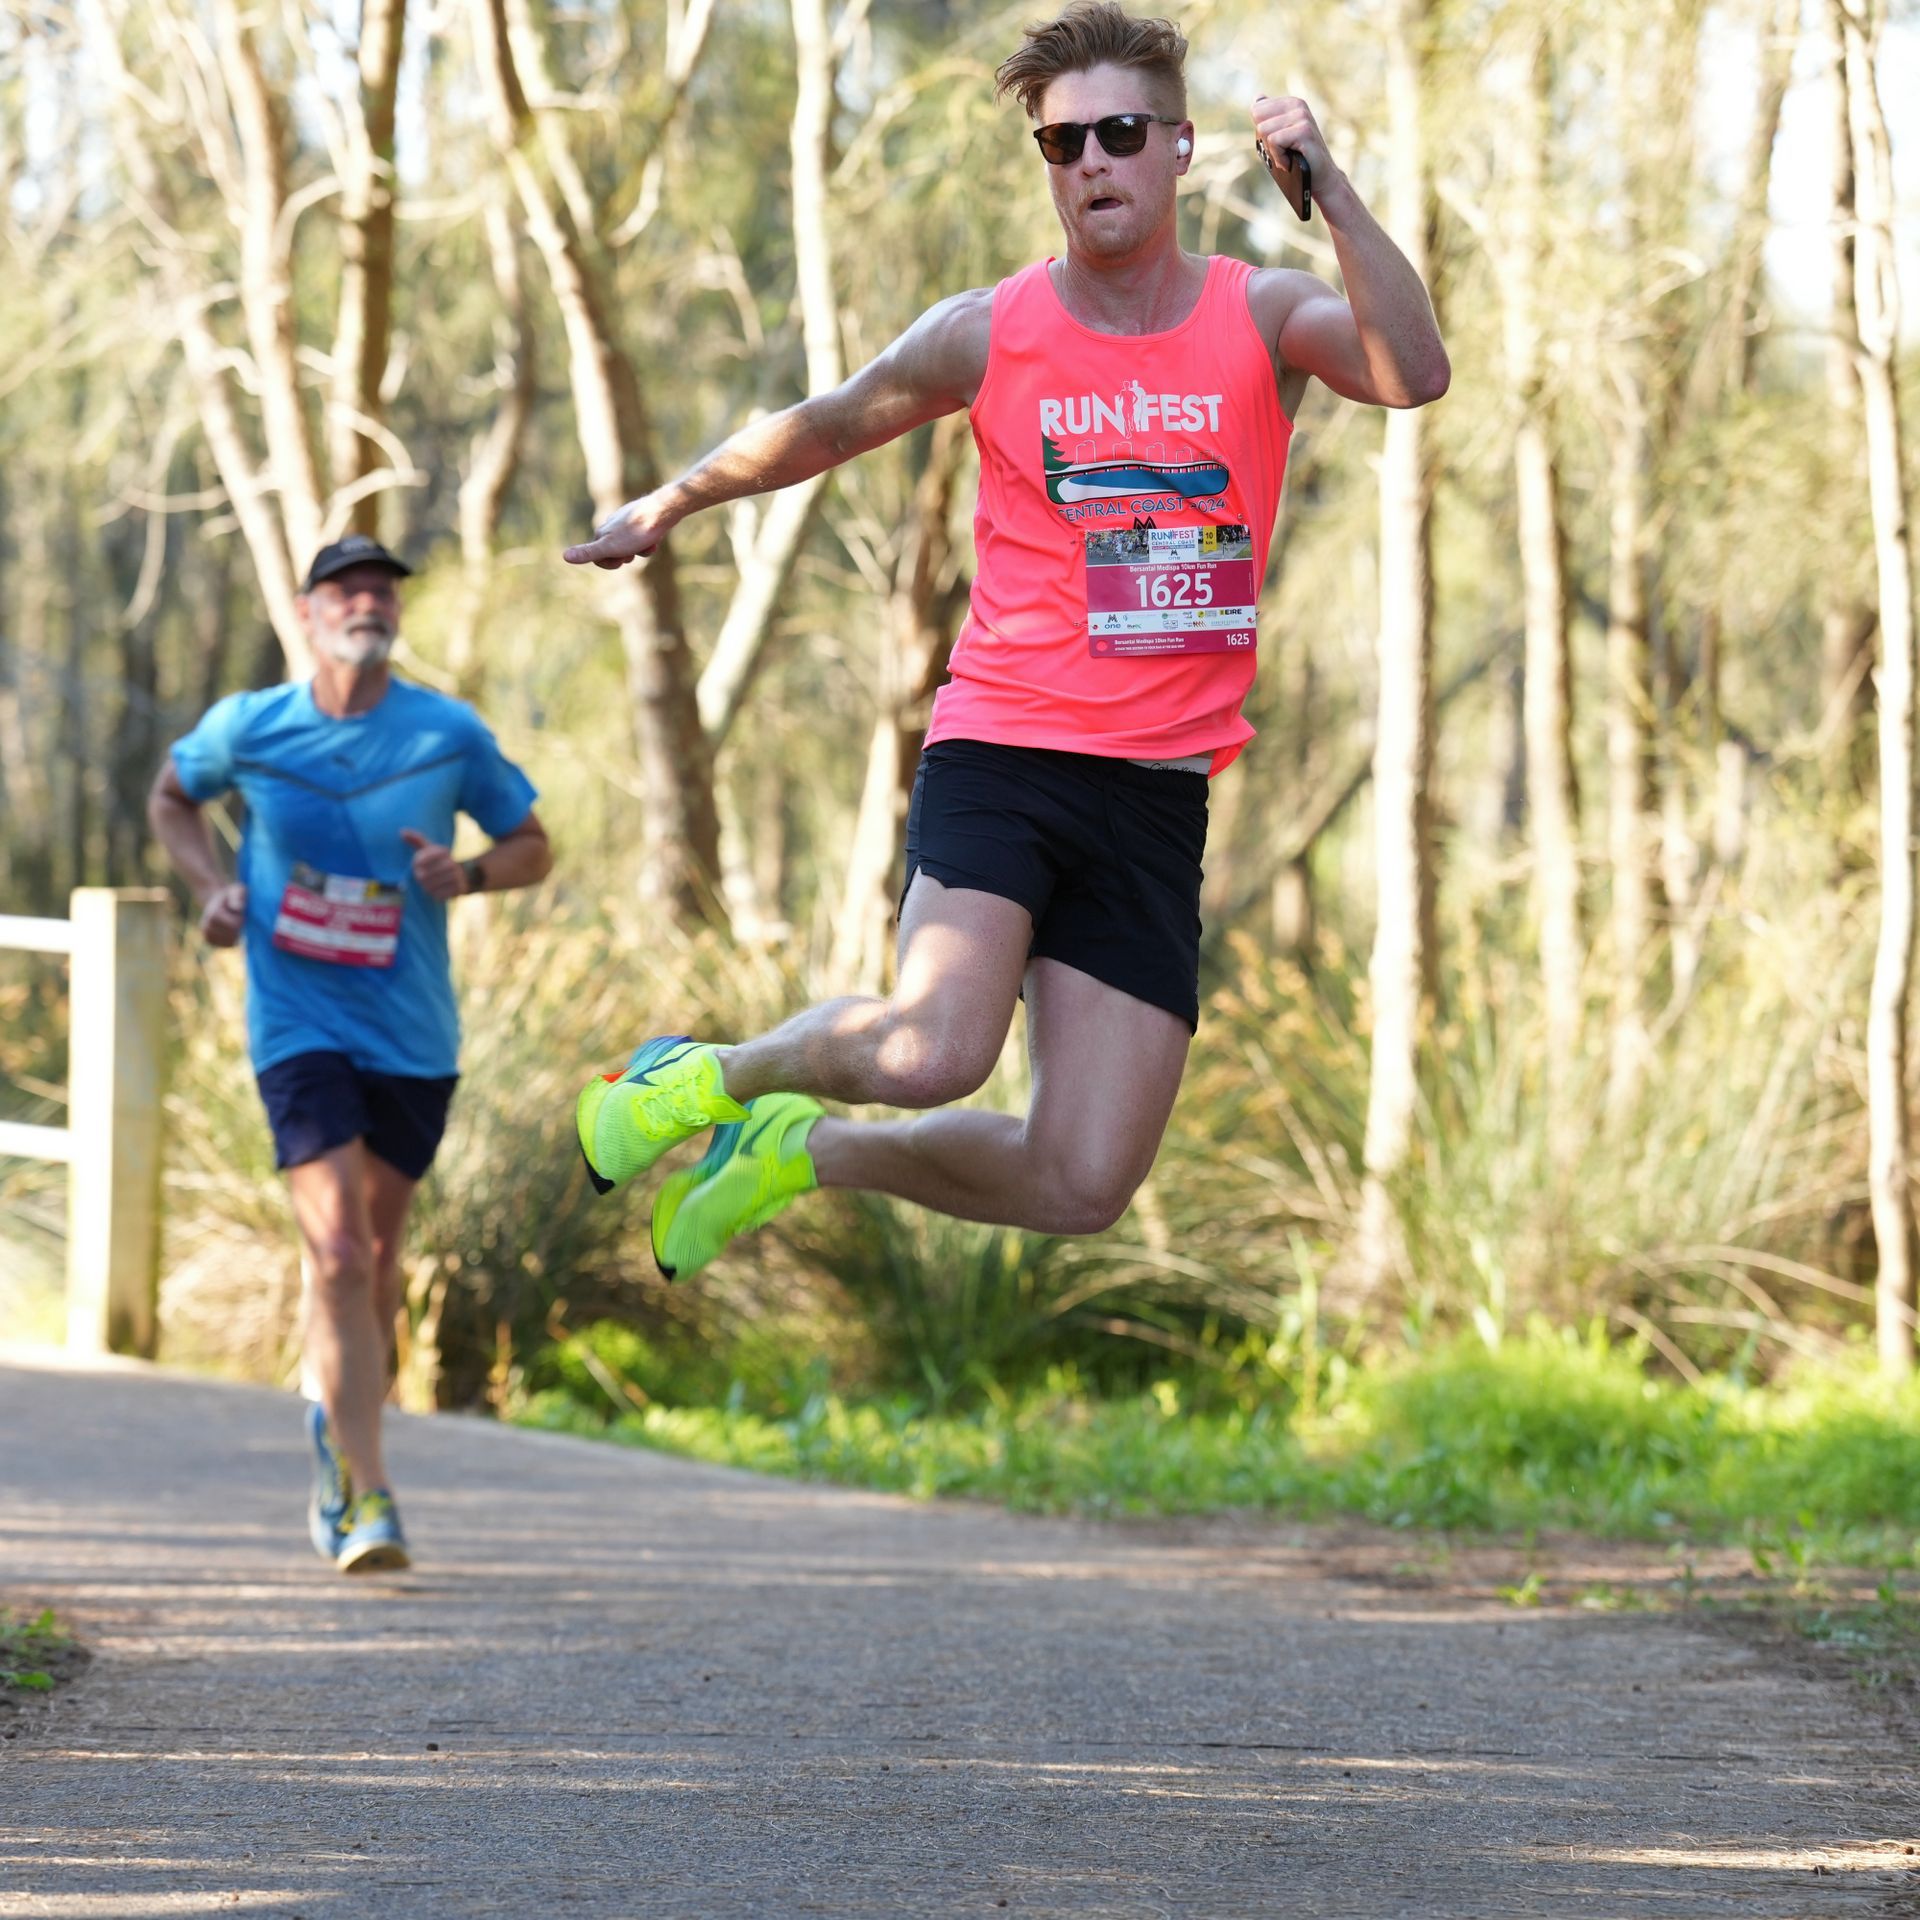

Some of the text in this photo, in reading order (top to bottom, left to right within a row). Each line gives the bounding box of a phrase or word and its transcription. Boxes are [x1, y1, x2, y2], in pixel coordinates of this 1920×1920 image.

[1131, 496, 1185, 514] COAST
[1157, 564, 1180, 572] Medispa
[1135, 572, 1213, 608] 1625
[1226, 633, 1250, 646] 1625
